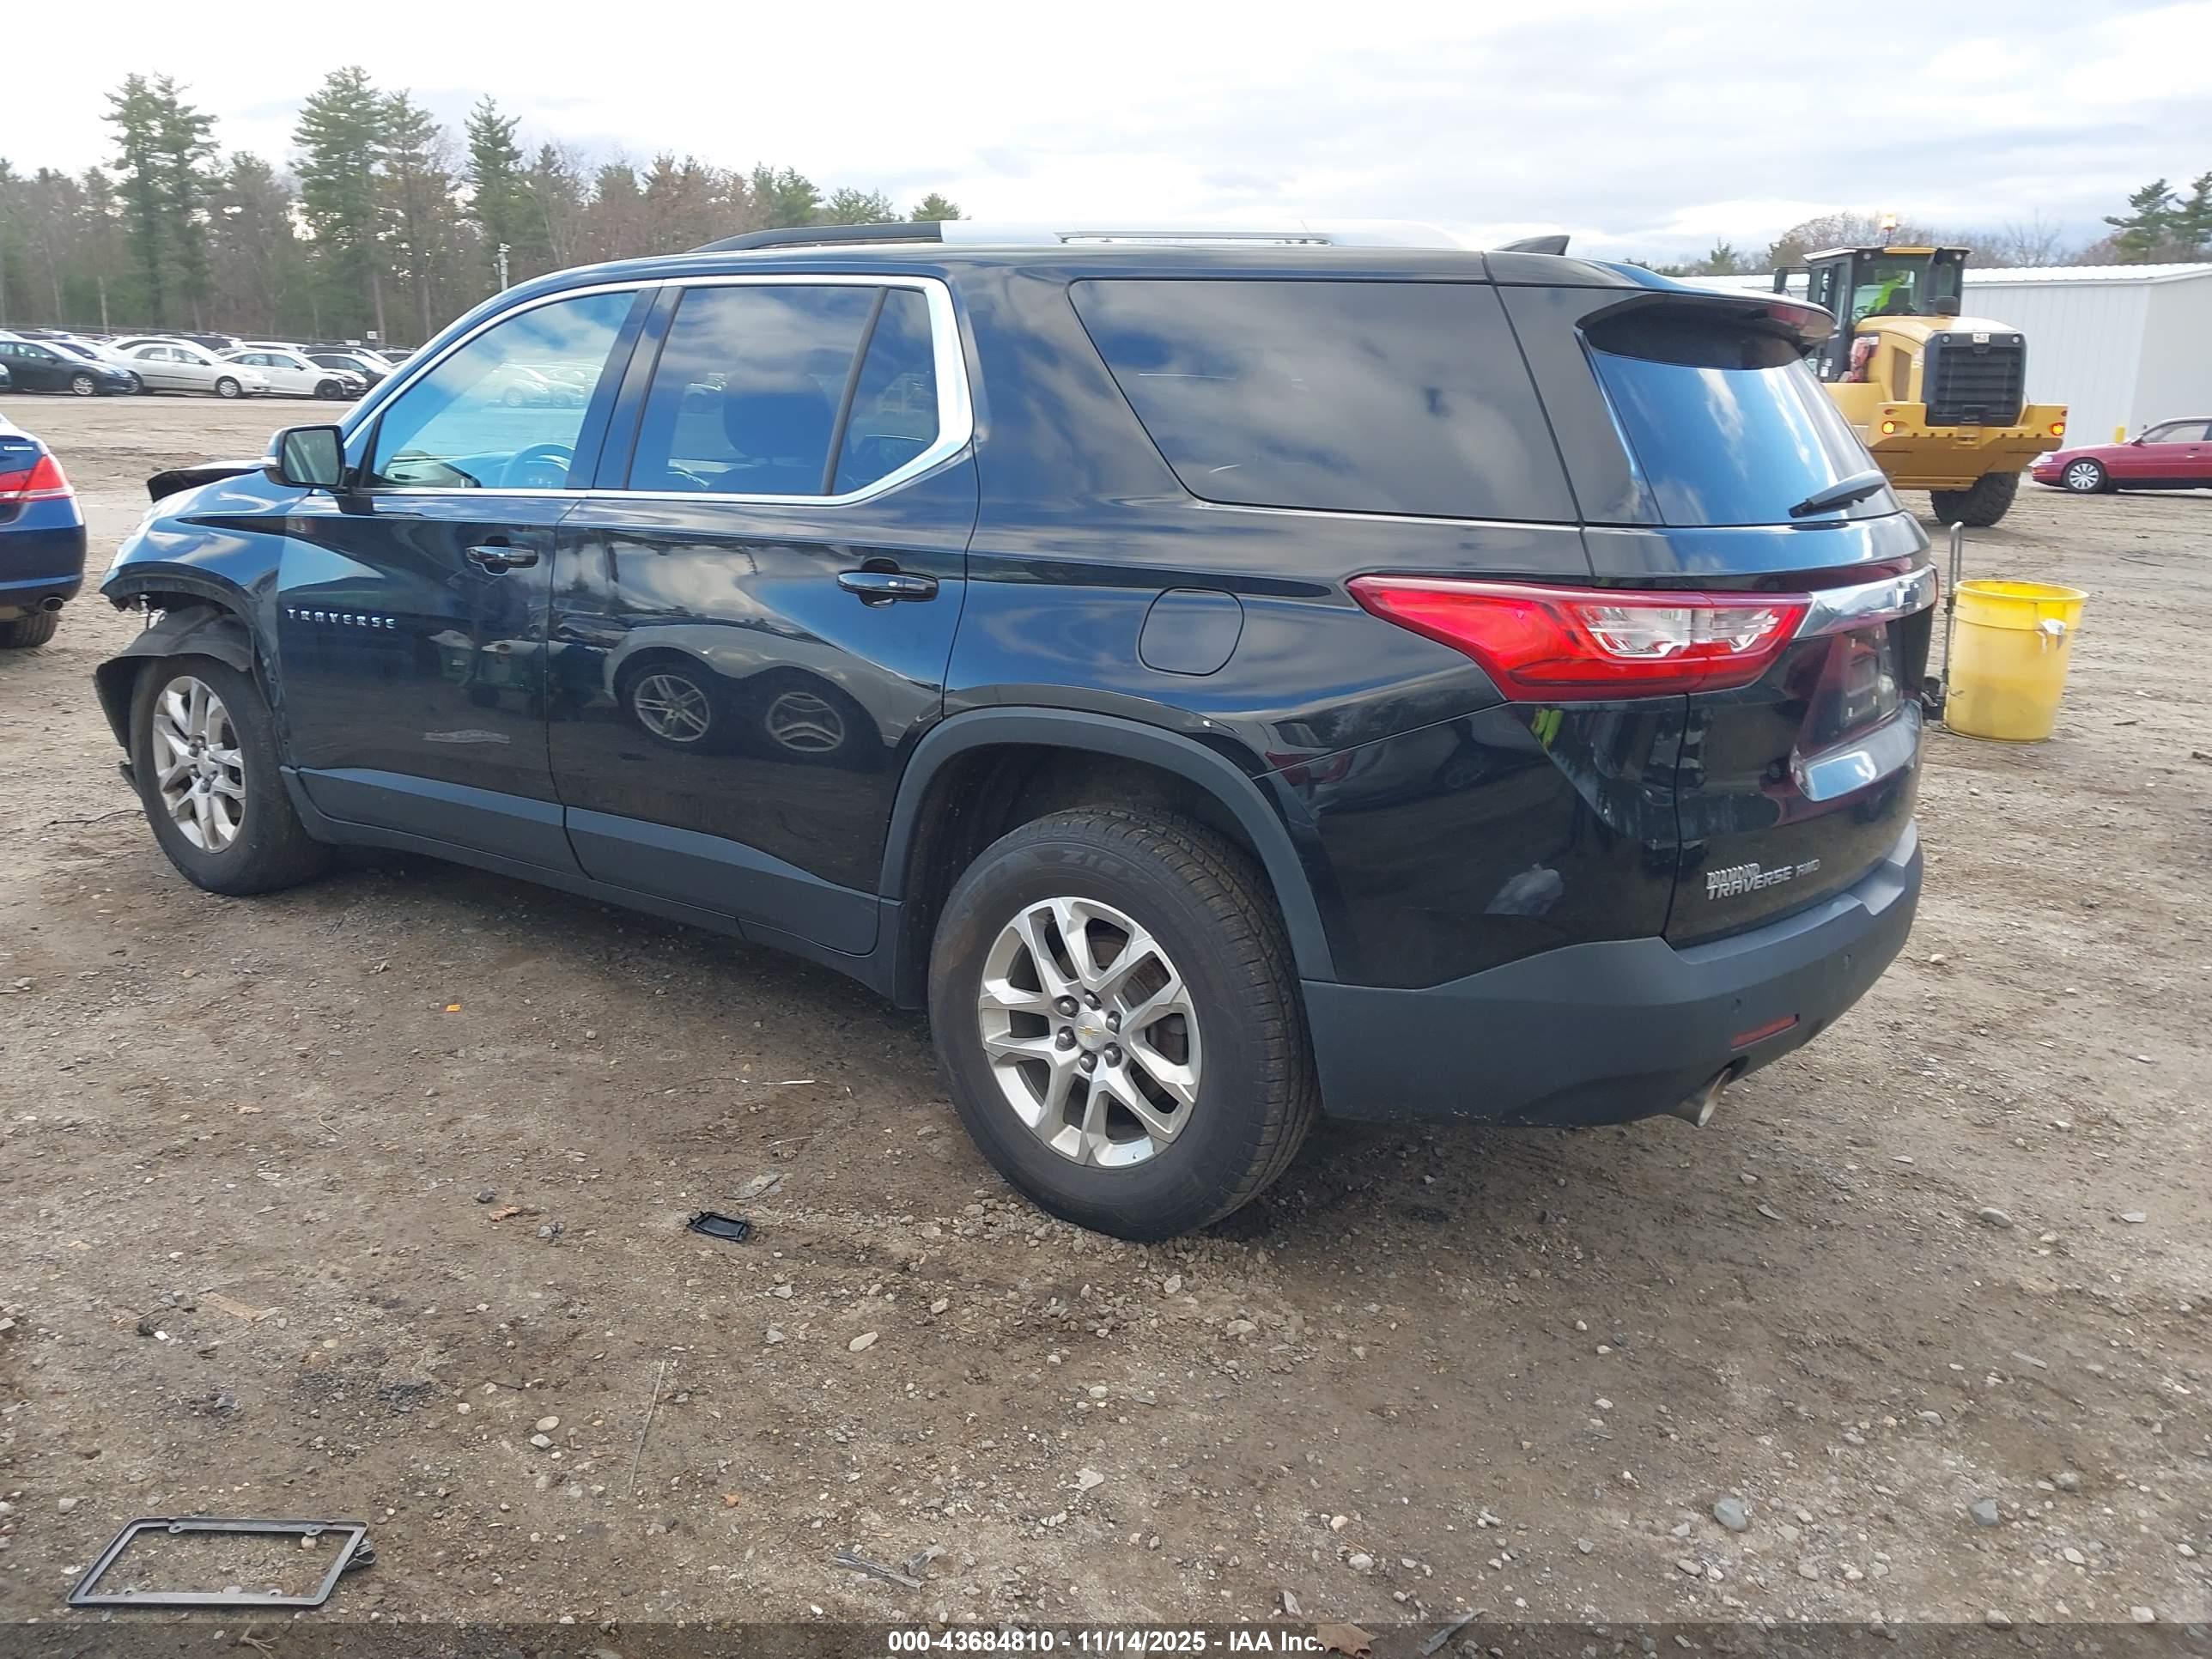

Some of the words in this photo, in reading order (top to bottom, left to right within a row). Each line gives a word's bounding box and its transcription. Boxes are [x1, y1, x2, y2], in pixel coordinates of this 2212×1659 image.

[287, 609, 396, 629] TRAVERSE
[1706, 862, 1760, 886] DIAMOND
[1706, 866, 1794, 900] TRAVERSE
